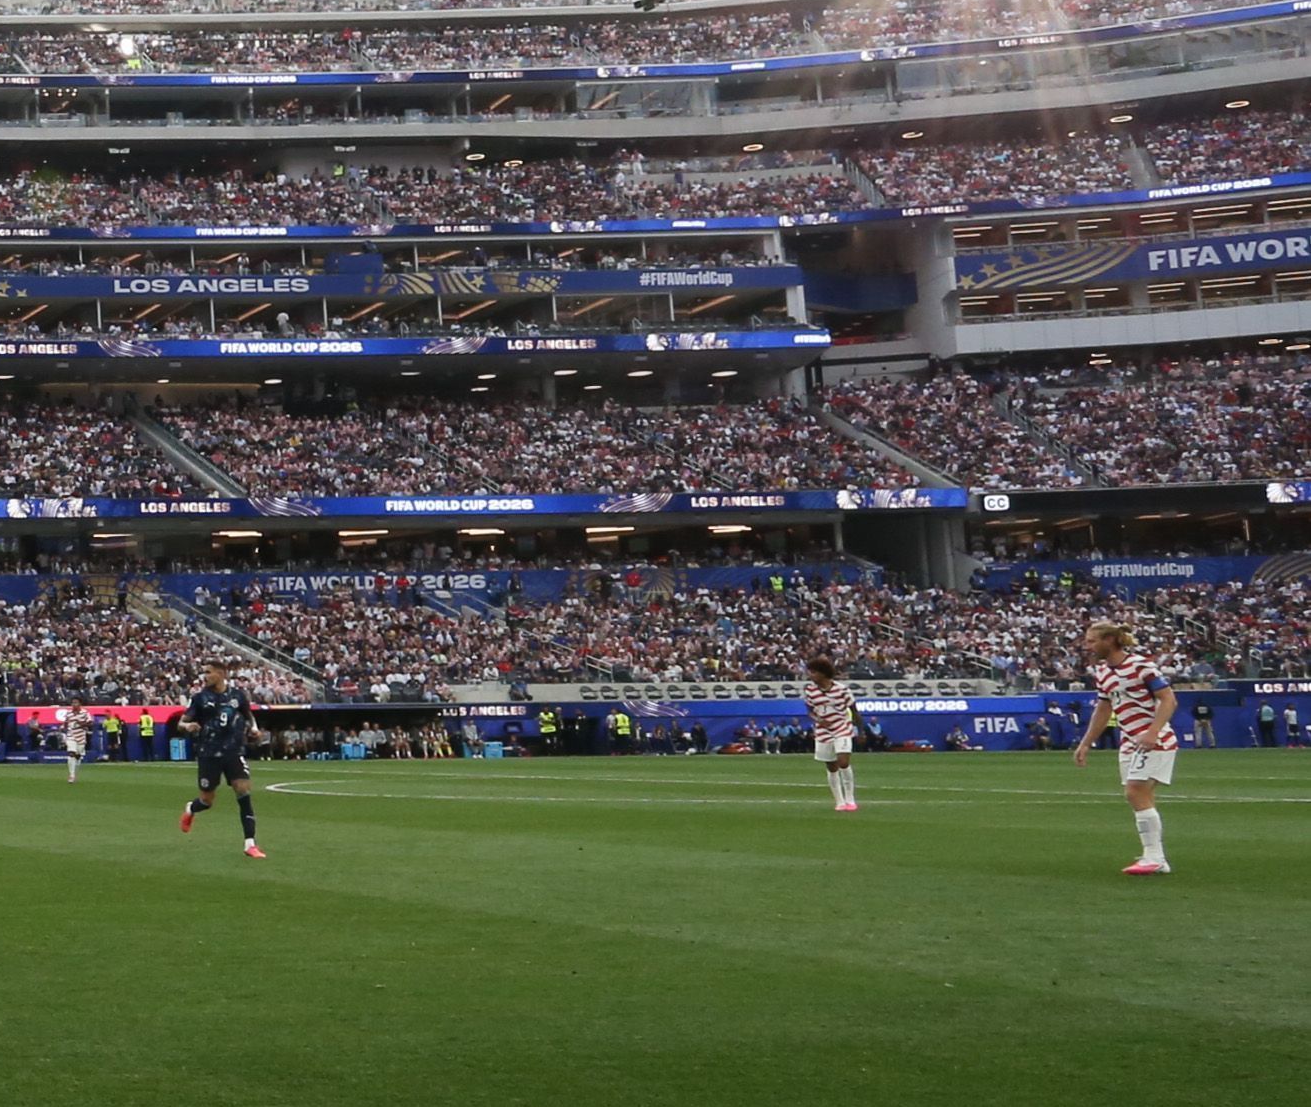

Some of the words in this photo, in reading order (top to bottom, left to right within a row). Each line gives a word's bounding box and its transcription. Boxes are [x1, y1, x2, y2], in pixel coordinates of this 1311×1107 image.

[1149, 186, 1171, 198] FIFA
[1173, 183, 1209, 196] WORLD
[1211, 181, 1232, 192] CUP
[1148, 245, 1221, 271] FIFA
[1225, 237, 1311, 263] WOR
[114, 279, 170, 293] LOS
[178, 278, 309, 293] ANGELES
[640, 272, 733, 287] #FIFAWorldCup
[18, 344, 77, 354] ANGELES
[221, 343, 247, 354] FIFA
[249, 343, 292, 354] WORLD
[294, 342, 317, 353] CUP
[319, 341, 363, 353] 2026
[507, 339, 533, 350] LOS
[536, 339, 596, 350] ANGELES
[140, 502, 168, 512] LOS
[170, 502, 230, 512] ANGELES
[386, 500, 414, 511] FIFA
[415, 500, 461, 511] WORLD
[462, 499, 487, 511] CUP
[488, 499, 534, 511] 2026
[691, 496, 718, 507] LOS
[723, 495, 784, 507] ANGELES
[987, 498, 1005, 509] CC
[1092, 562, 1193, 578] #FIFAWorldCup
[1255, 683, 1284, 693] LOS
[469, 706, 526, 716] ANGELES
[855, 701, 898, 712] WORLD
[900, 701, 923, 712] CUP
[925, 700, 968, 712] 2026
[220, 714, 227, 726] 9
[975, 717, 1019, 733] FIFA
